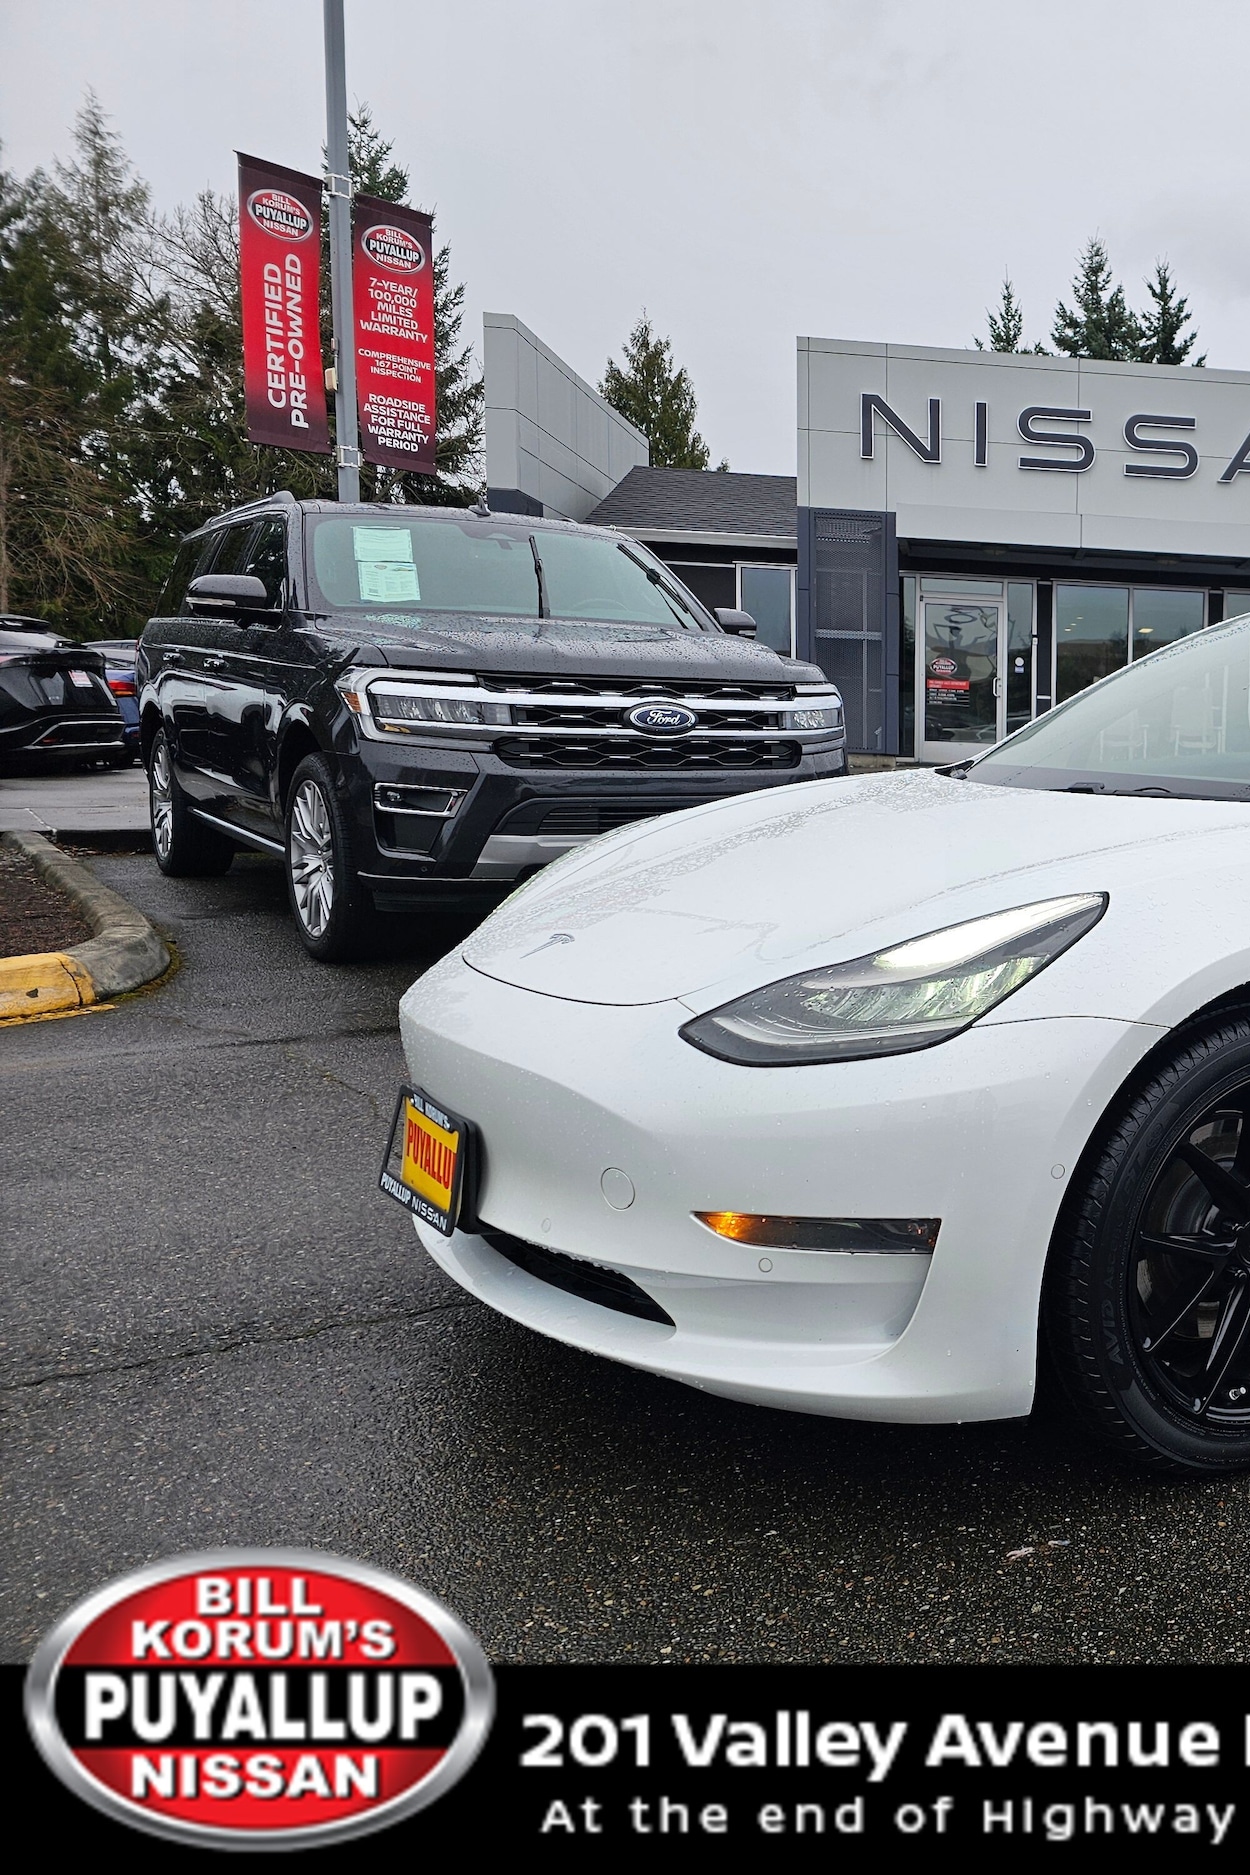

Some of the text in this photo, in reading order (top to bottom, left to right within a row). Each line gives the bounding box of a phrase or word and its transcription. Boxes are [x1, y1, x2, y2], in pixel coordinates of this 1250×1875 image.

[262, 198, 300, 215] KORUM'S
[272, 194, 291, 205] BILL
[255, 204, 307, 230] PUYALLUP
[263, 219, 298, 236] NISSAN
[385, 229, 402, 240] BILL
[376, 233, 413, 249] KORUM'S
[370, 240, 420, 262] PUYALLUP
[376, 253, 412, 269] NISSAN
[370, 277, 418, 298] 7-YEAR/
[368, 289, 417, 308] 100,000
[377, 302, 413, 318] MILES
[371, 311, 418, 330] LIMITED
[264, 263, 286, 408] CERTIFIED
[285, 254, 309, 428] PRE-OWNED
[360, 320, 428, 343] WARRANTY
[358, 348, 431, 370] COMPREHENSIVE
[392, 363, 417, 374] POINT
[370, 366, 422, 383] INSPECTION
[369, 393, 425, 413] ROADSIDE
[364, 403, 431, 424] ASSISTANCE
[371, 414, 423, 433] FOR FULL
[368, 424, 429, 444] WARRANTY
[378, 436, 418, 452] PERIOD
[647, 710, 681, 725] Ford
[406, 1118, 457, 1190] PUYALLU
[380, 1172, 448, 1231] PUYALLUP NISSAN
